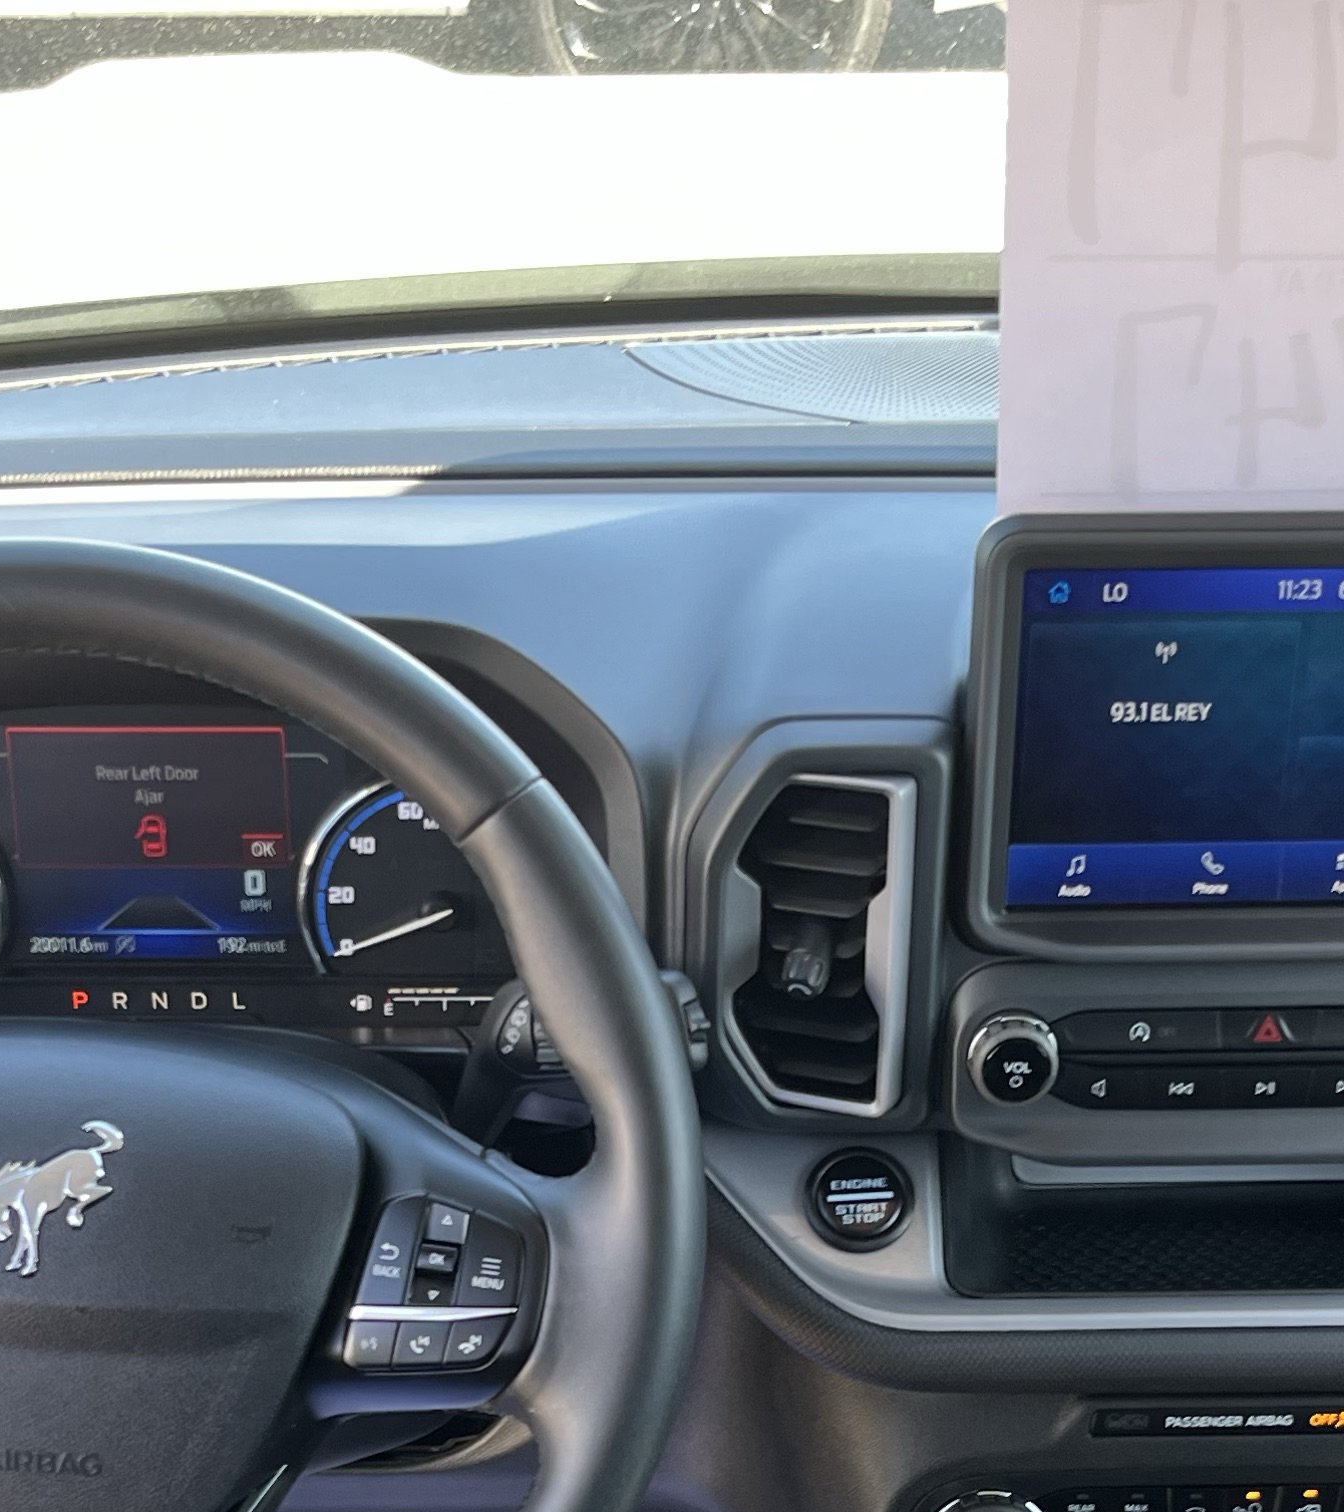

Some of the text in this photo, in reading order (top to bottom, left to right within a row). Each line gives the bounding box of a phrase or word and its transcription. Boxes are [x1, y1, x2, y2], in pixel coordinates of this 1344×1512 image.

[1102, 582, 1129, 602] LO
[1278, 578, 1322, 601] 11:23
[1110, 702, 1212, 723] 93.1 EL REY
[95, 765, 199, 780] Rear Left Door
[135, 788, 164, 806] Ajar
[397, 802, 424, 820] 60
[251, 841, 276, 857] OK
[349, 836, 376, 855] 40
[244, 869, 266, 896] 0
[1192, 882, 1229, 895] Phone
[328, 886, 355, 904] 20
[71, 992, 246, 1010] P R N D L
[383, 1002, 394, 1016] E
[1003, 1061, 1032, 1074] VOL
[830, 1177, 888, 1190] ENGINE
[835, 1202, 888, 1215] START
[842, 1212, 886, 1225] STOP
[428, 1253, 445, 1265] OK
[372, 1264, 401, 1278] BACK
[471, 1276, 504, 1290] MENU
[1164, 1414, 1243, 1428] PASSENGER
[1245, 1414, 1294, 1428] AIRBAG
[1309, 1413, 1339, 1427] OFF
